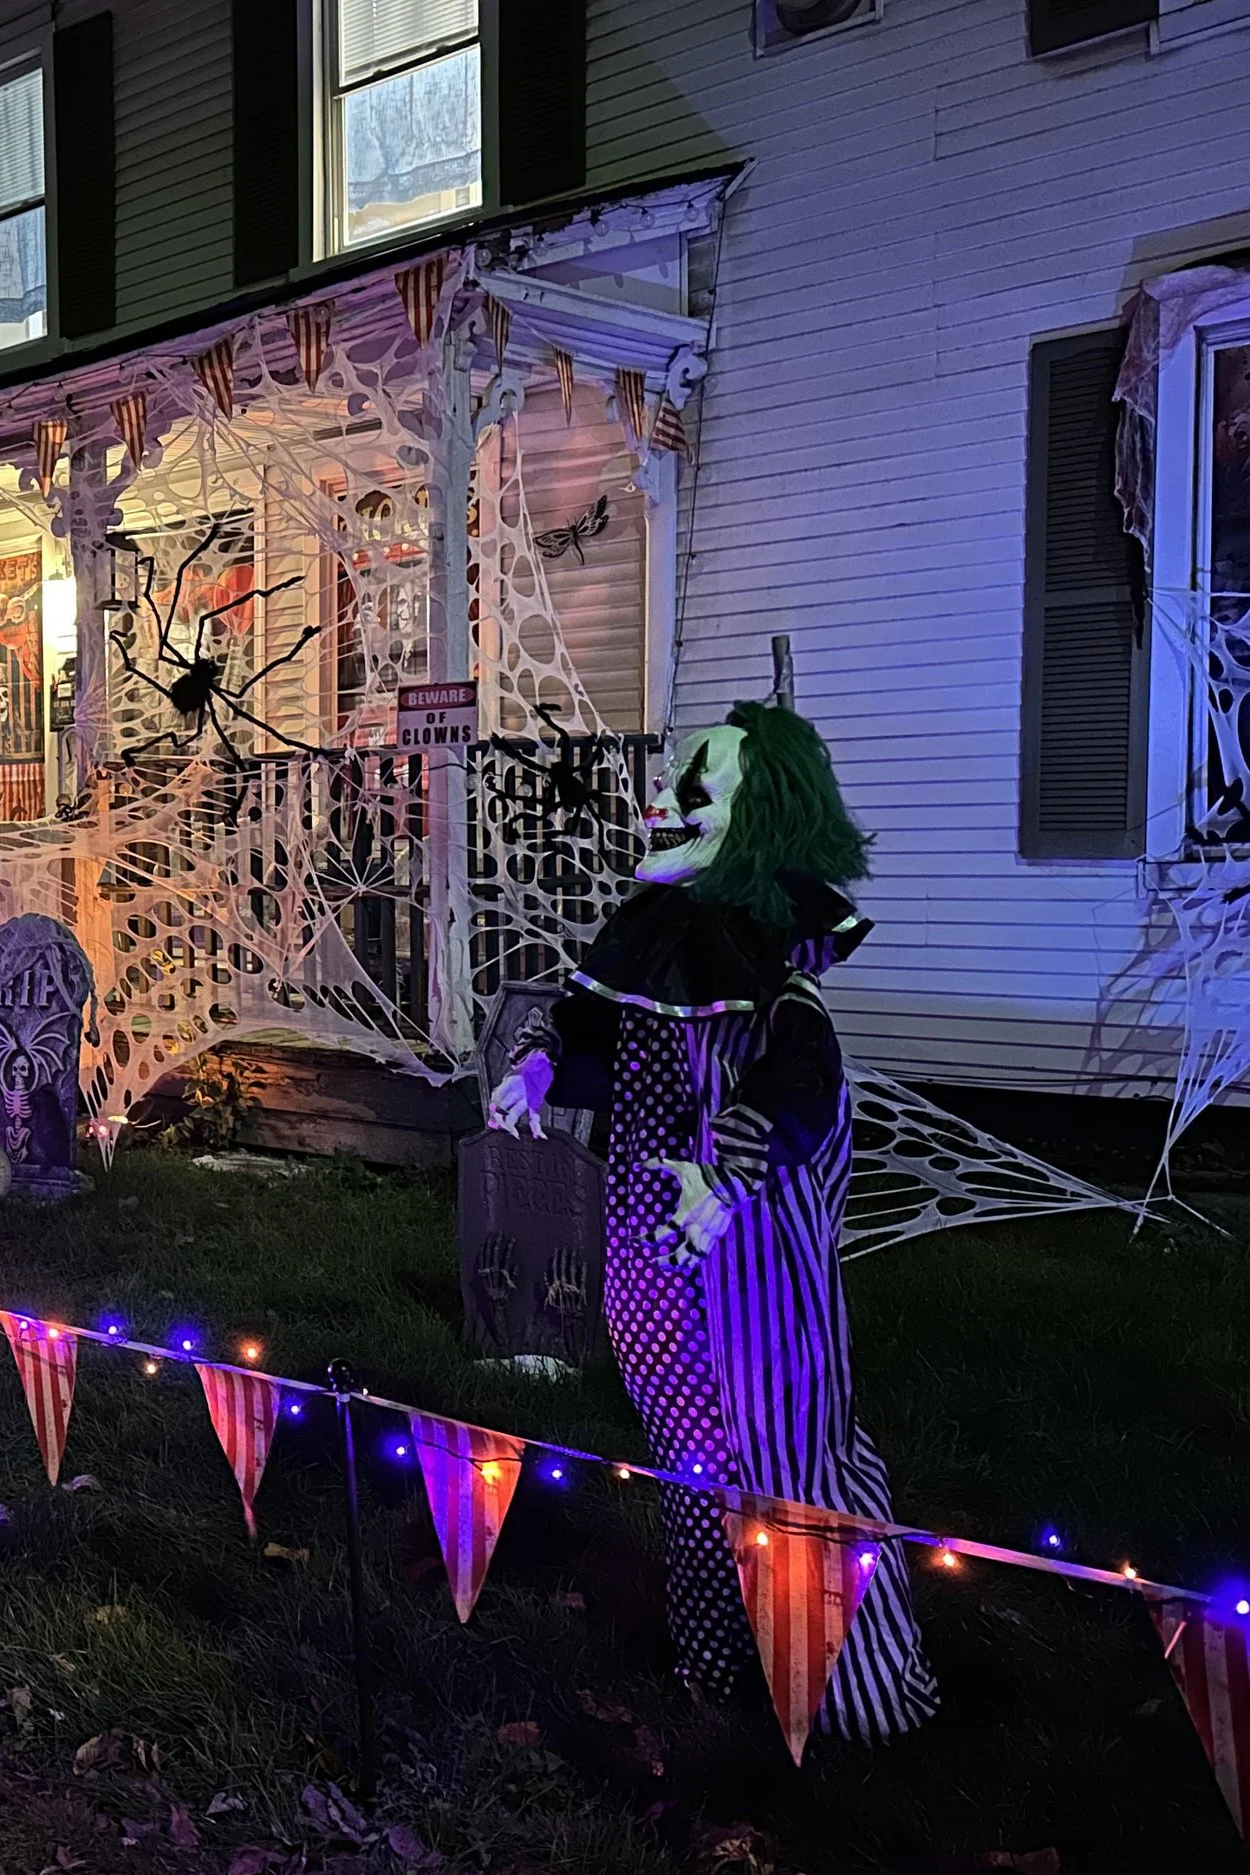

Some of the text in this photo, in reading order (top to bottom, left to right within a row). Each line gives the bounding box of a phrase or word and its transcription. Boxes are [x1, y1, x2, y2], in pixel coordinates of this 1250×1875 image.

[408, 688, 466, 705] BEWARE
[426, 712, 446, 724] OF
[402, 725, 470, 745] CLOWNS
[479, 1169, 588, 1217] PIECES
